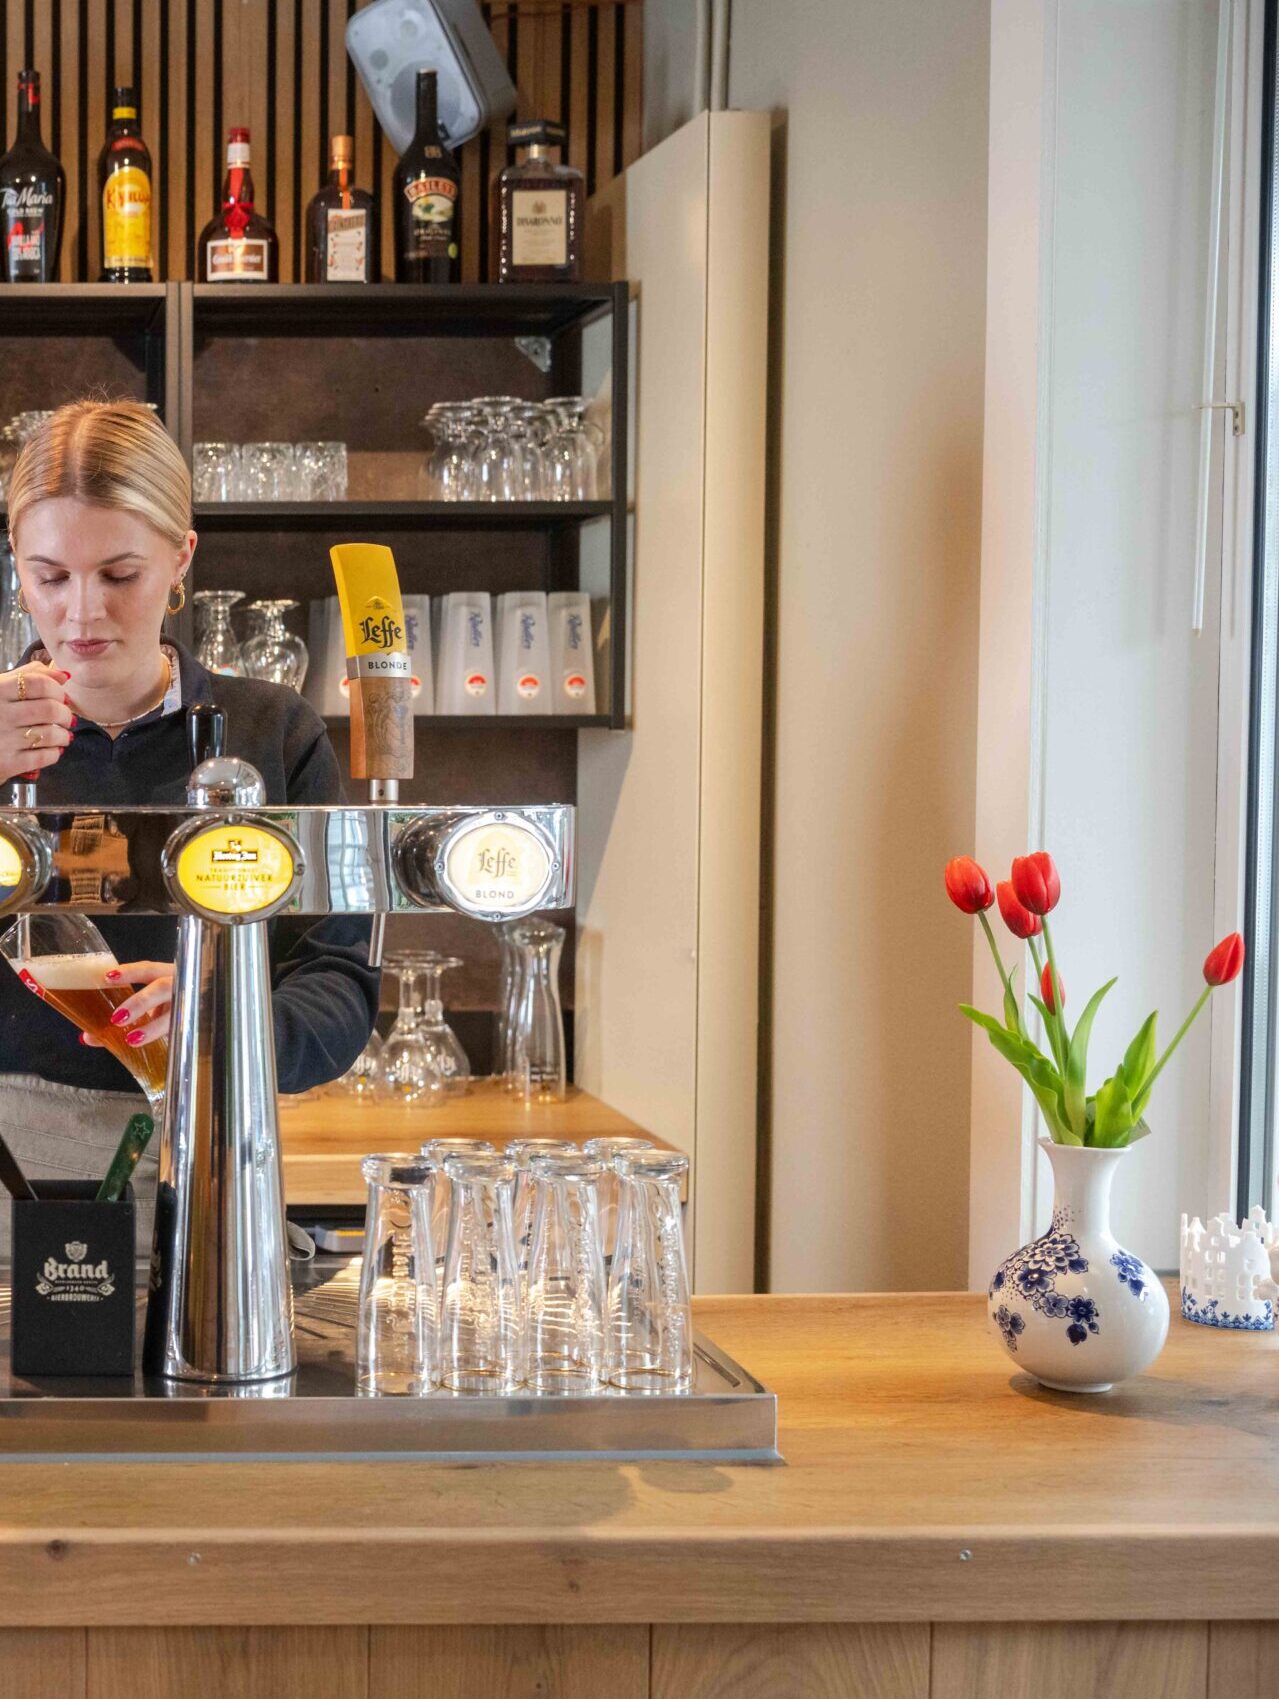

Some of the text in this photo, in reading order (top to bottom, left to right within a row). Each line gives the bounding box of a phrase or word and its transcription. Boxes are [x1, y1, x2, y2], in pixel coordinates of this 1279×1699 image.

[16, 186, 54, 208] Maria
[359, 615, 403, 649] Leffe
[368, 661, 407, 671] BLONDE
[478, 847, 517, 878] Leffe
[475, 889, 515, 899] BLOND
[44, 1256, 109, 1281] Brand
